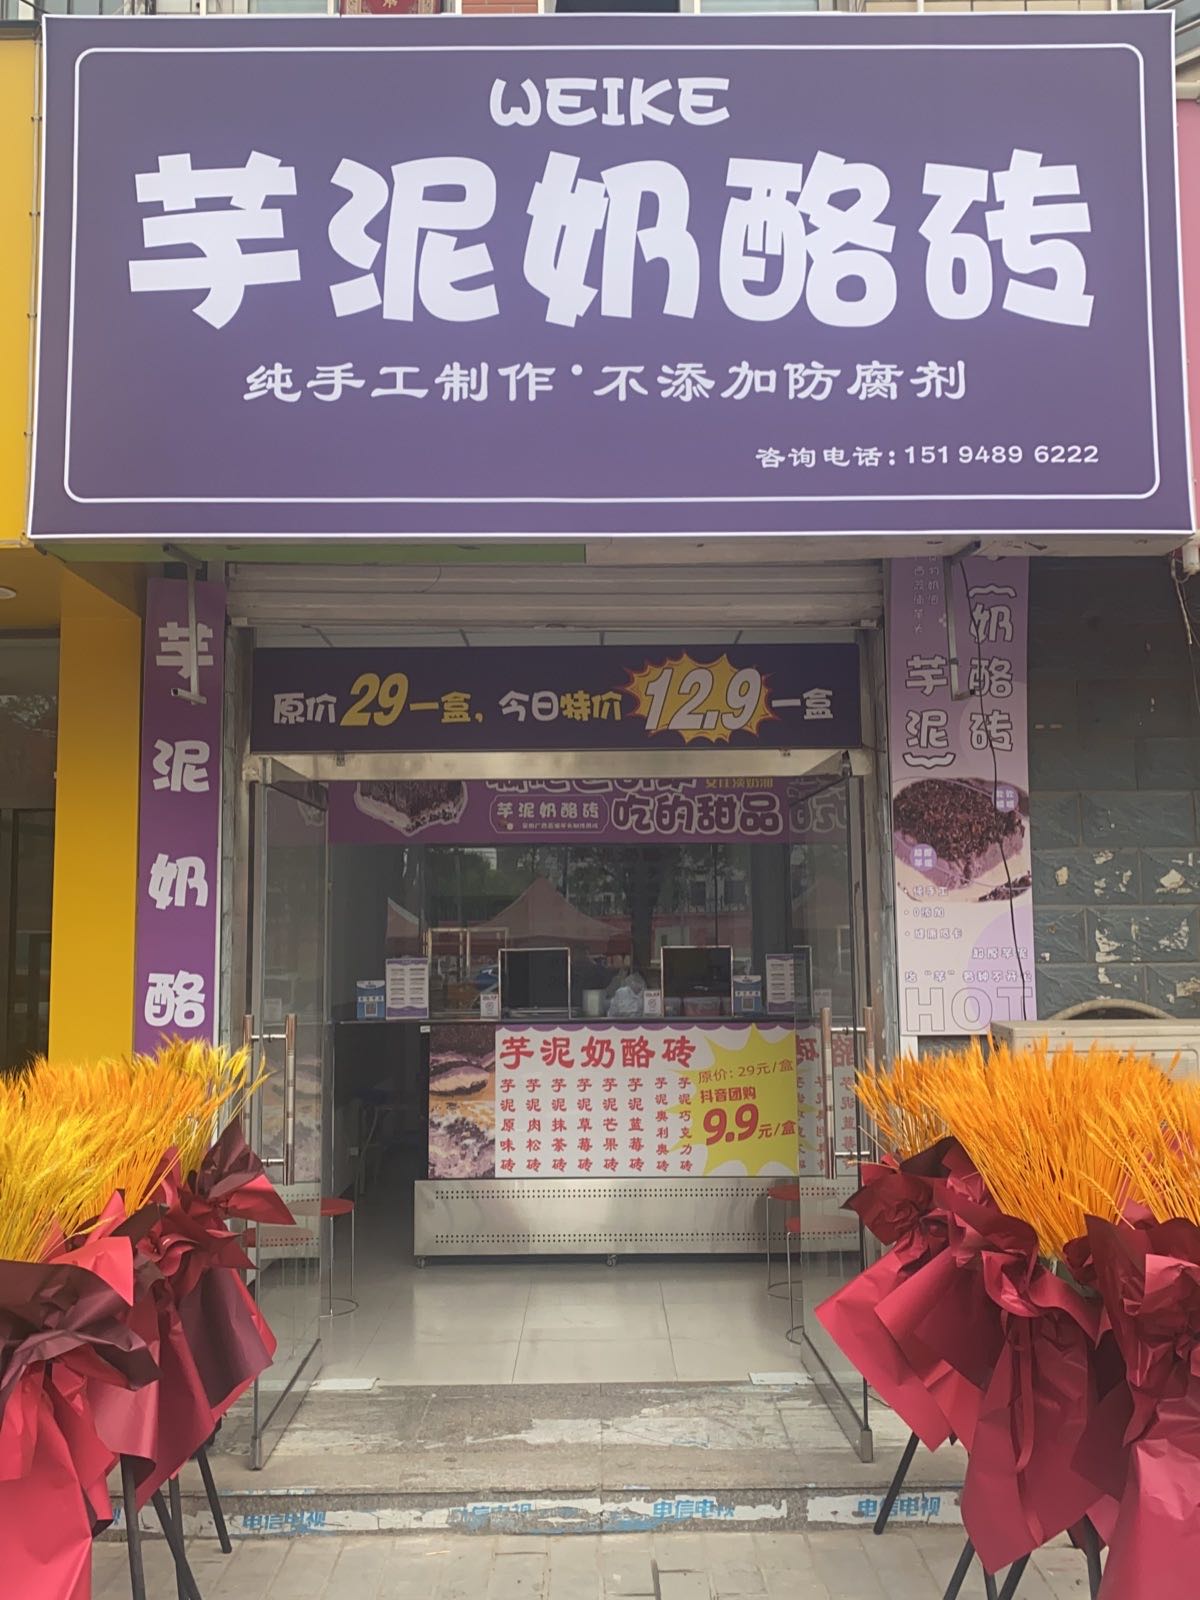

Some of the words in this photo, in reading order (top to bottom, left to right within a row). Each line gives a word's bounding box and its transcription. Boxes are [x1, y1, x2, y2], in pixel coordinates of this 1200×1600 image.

[489, 77, 730, 127] WEIKE
[129, 149, 1094, 329] 芋泥奶酪砖
[1034, 445, 1100, 464] 6222
[144, 621, 215, 1029] 芋泥奶酪
[496, 801, 600, 819] 芋泥奶酪砖
[611, 793, 783, 834] 吃的甜品
[499, 1034, 697, 1070] 芋泥奶酪砖
[904, 986, 1034, 1032] HOT
[500, 1076, 516, 1173] 芋泥原味砖
[525, 1076, 542, 1173] 芋泥肉松砖
[551, 1076, 567, 1173] 芋泥抹茶砖
[576, 1076, 593, 1173] 芋泥草莓砖
[602, 1076, 619, 1173] 芋泥芒果砖
[627, 1076, 645, 1173] 芋泥蓝莓砖
[655, 1076, 669, 1173] 芋泥奥利奥砖
[678, 1076, 693, 1173] 芋泥巧克力砖
[699, 1086, 757, 1104] 抖音团购
